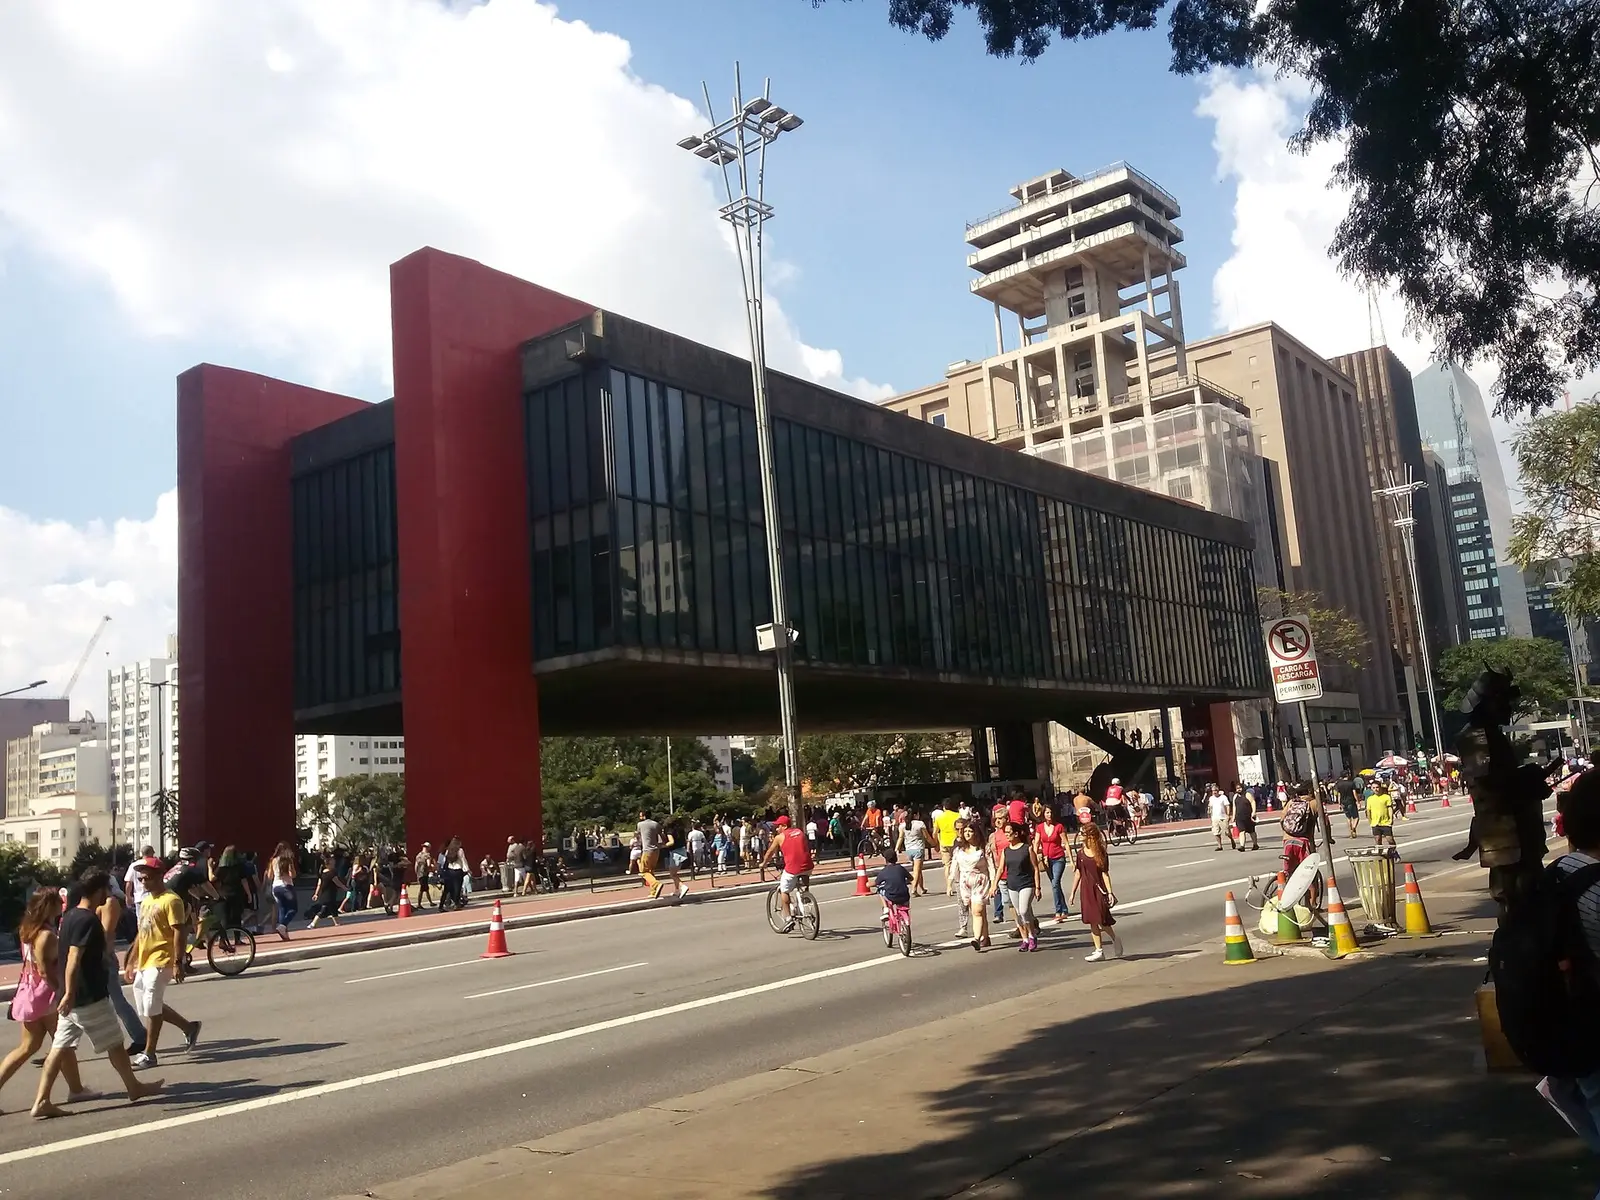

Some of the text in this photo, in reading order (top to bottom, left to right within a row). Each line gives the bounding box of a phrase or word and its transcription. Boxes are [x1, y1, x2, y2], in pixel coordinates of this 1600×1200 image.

[1279, 664, 1303, 674] CARGA
[1277, 669, 1314, 681] DESCARGA
[1280, 683, 1316, 694] PERMITIDA
